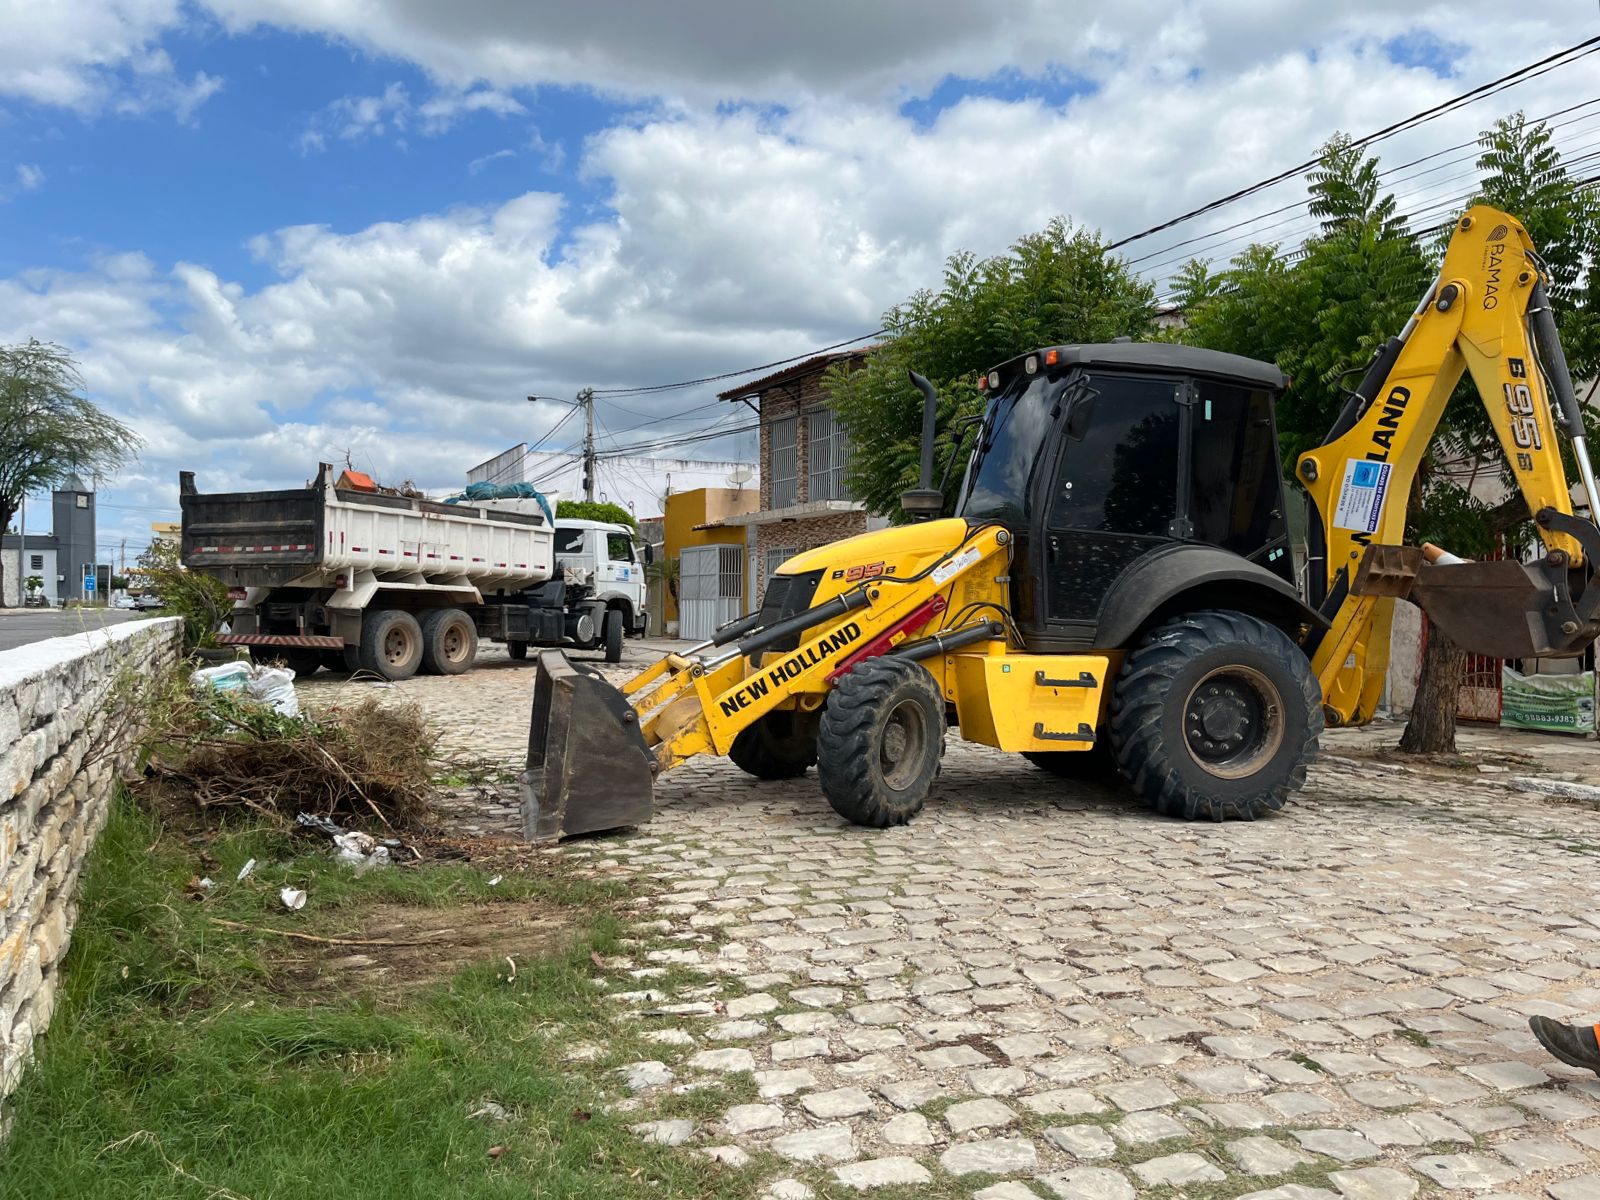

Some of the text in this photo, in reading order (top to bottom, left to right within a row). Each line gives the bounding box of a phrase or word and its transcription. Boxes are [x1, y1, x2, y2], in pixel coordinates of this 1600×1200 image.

[1483, 244, 1505, 311] BAMAQ
[1366, 385, 1411, 462] LAND
[719, 622, 861, 718] NEW HOLLAND
